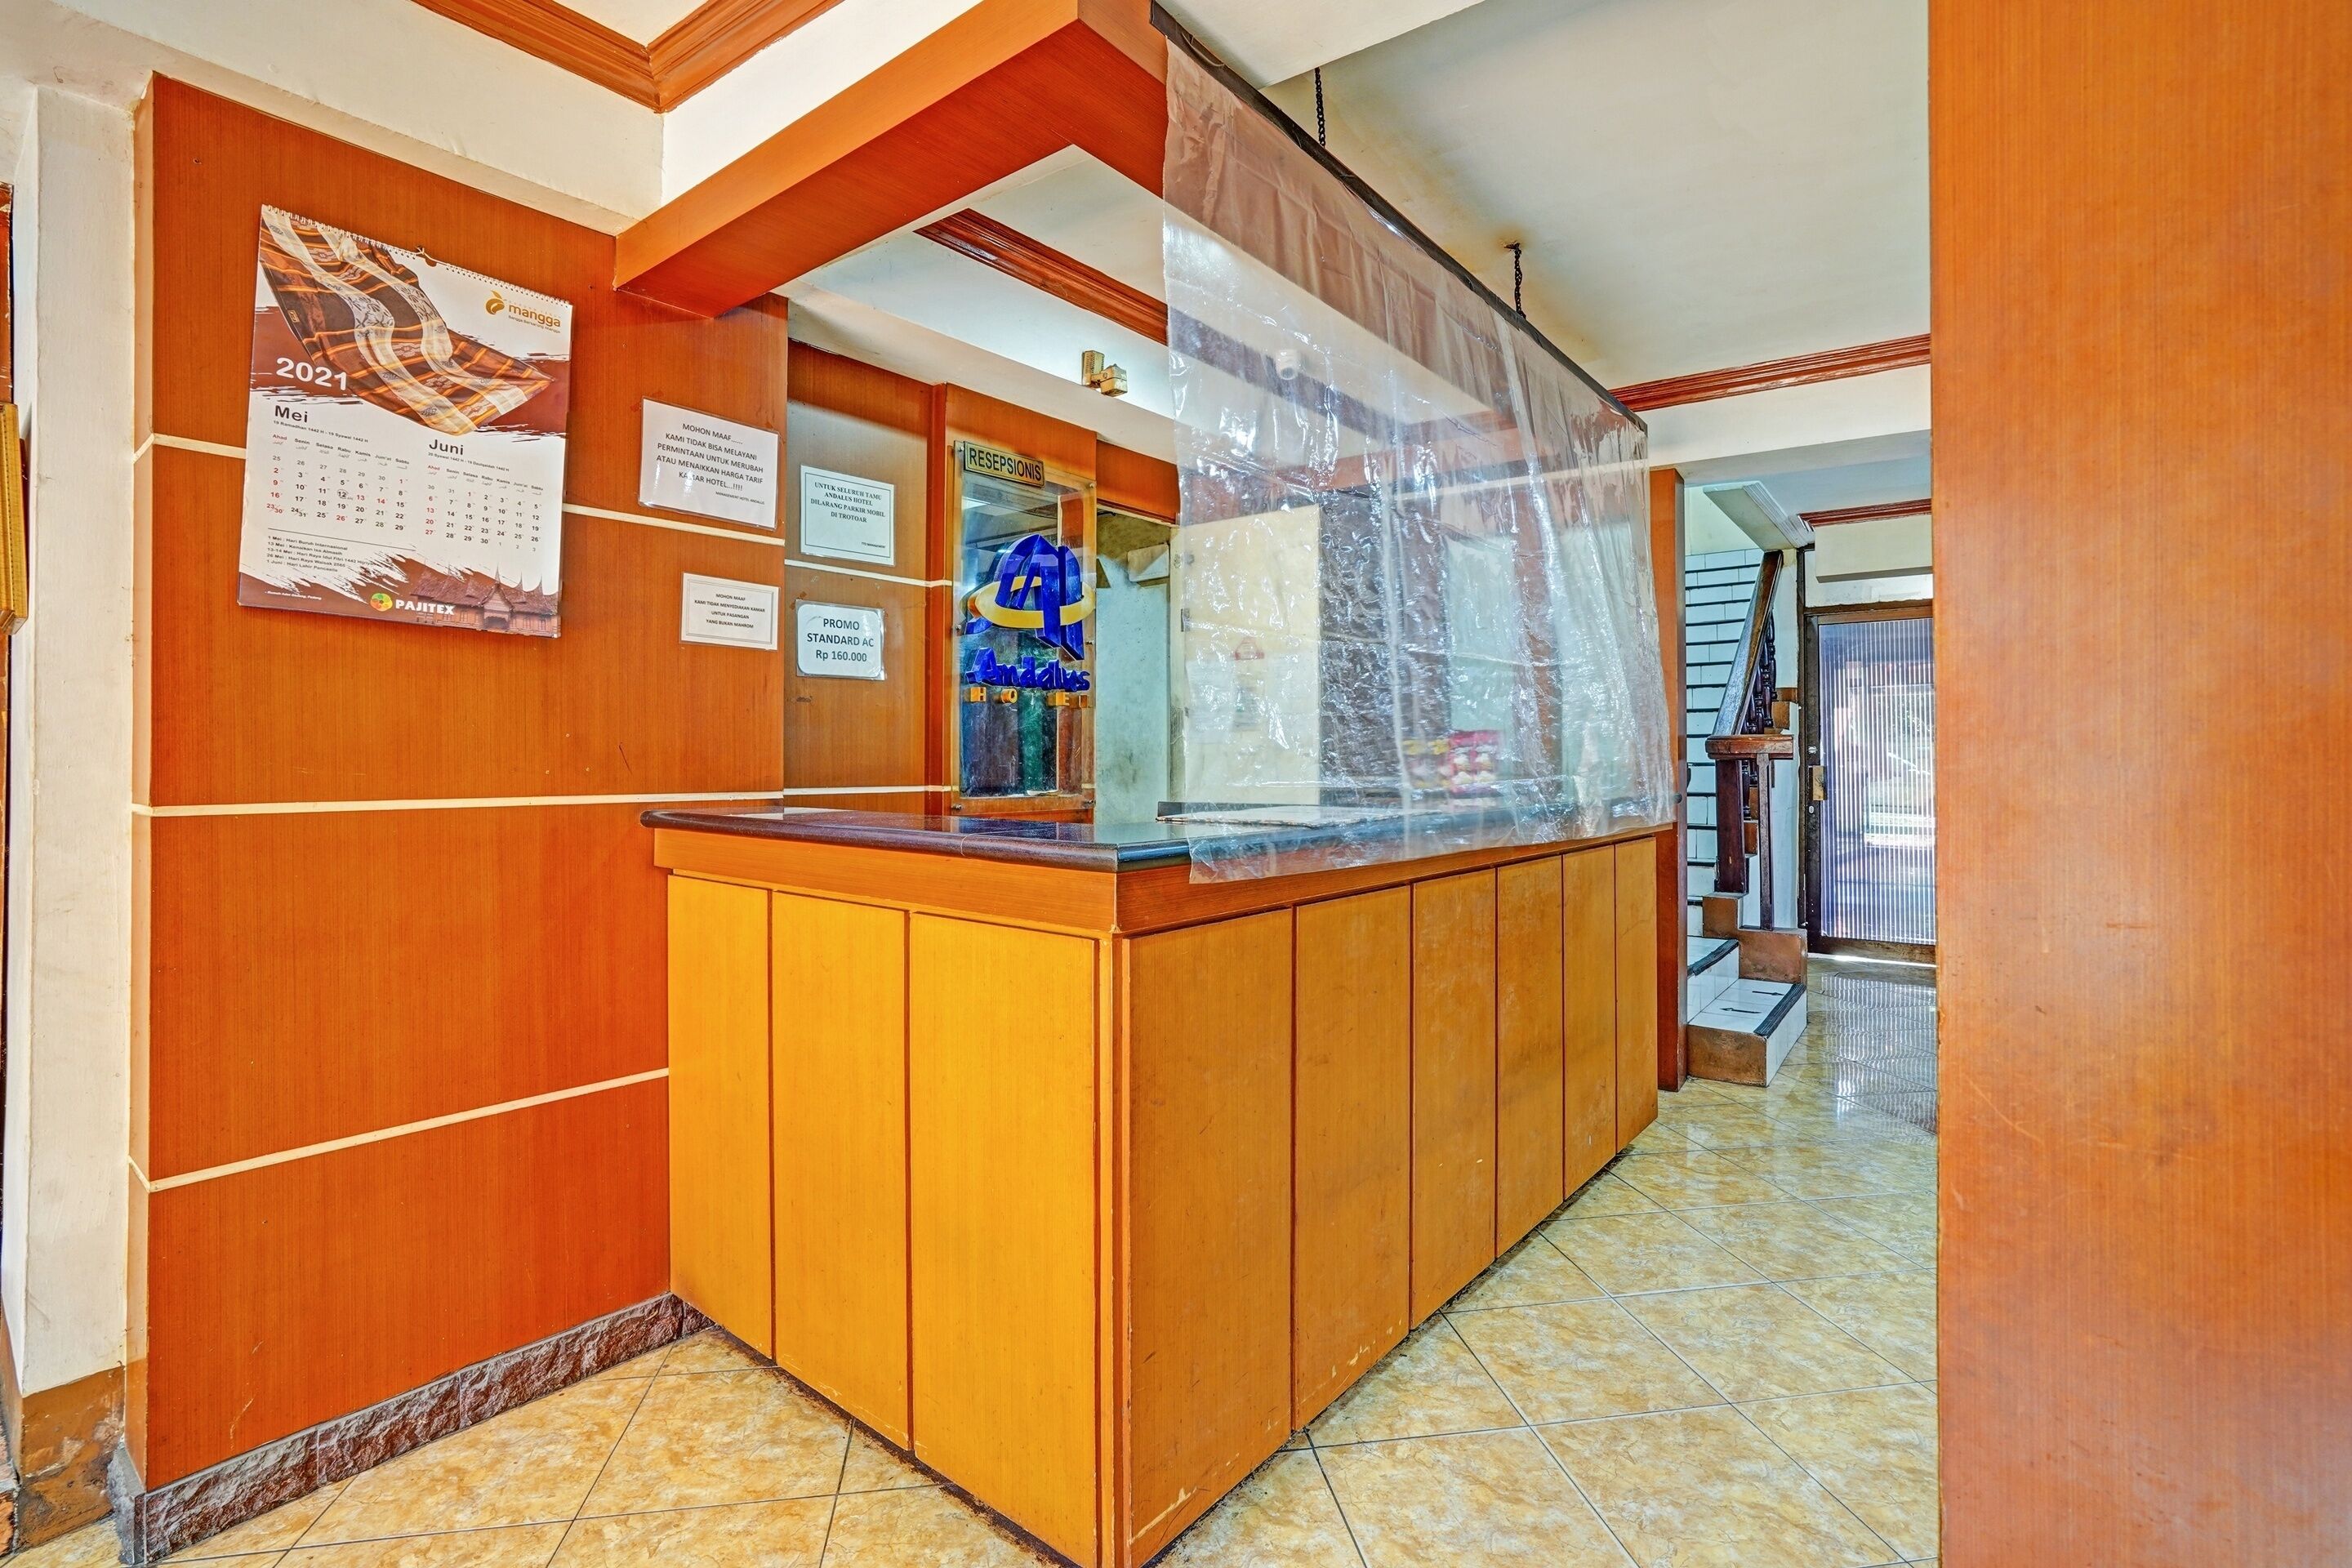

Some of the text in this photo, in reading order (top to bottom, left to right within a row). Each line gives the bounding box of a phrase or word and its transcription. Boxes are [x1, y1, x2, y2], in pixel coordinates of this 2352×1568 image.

[509, 305, 560, 327] mangga
[276, 357, 346, 391] 2021
[275, 405, 308, 423] Mei
[683, 423, 710, 436] MOHON
[429, 439, 464, 455] Juni
[666, 433, 757, 461] KAMI TIDAK BISA MELAYANI
[657, 443, 764, 473] PERMINTAAN UNTUK MERUBAH
[969, 448, 1042, 481] RESEPSIONIS
[657, 455, 764, 483] ATAU MENAIKKAN HARGA TARIF
[814, 482, 835, 492] UNTUK
[837, 487, 864, 497] SELURUH
[811, 498, 885, 517] DILARANG PARKIR MOBIL
[825, 492, 873, 506] ANDALUS HOTEL
[839, 513, 867, 523] TROTOAR
[396, 599, 455, 615] PAJITEX
[823, 618, 860, 630] PROMO
[807, 633, 874, 647] STANDARD AC
[817, 649, 867, 662] Rp 160.000
[966, 648, 1090, 692] Andalus
